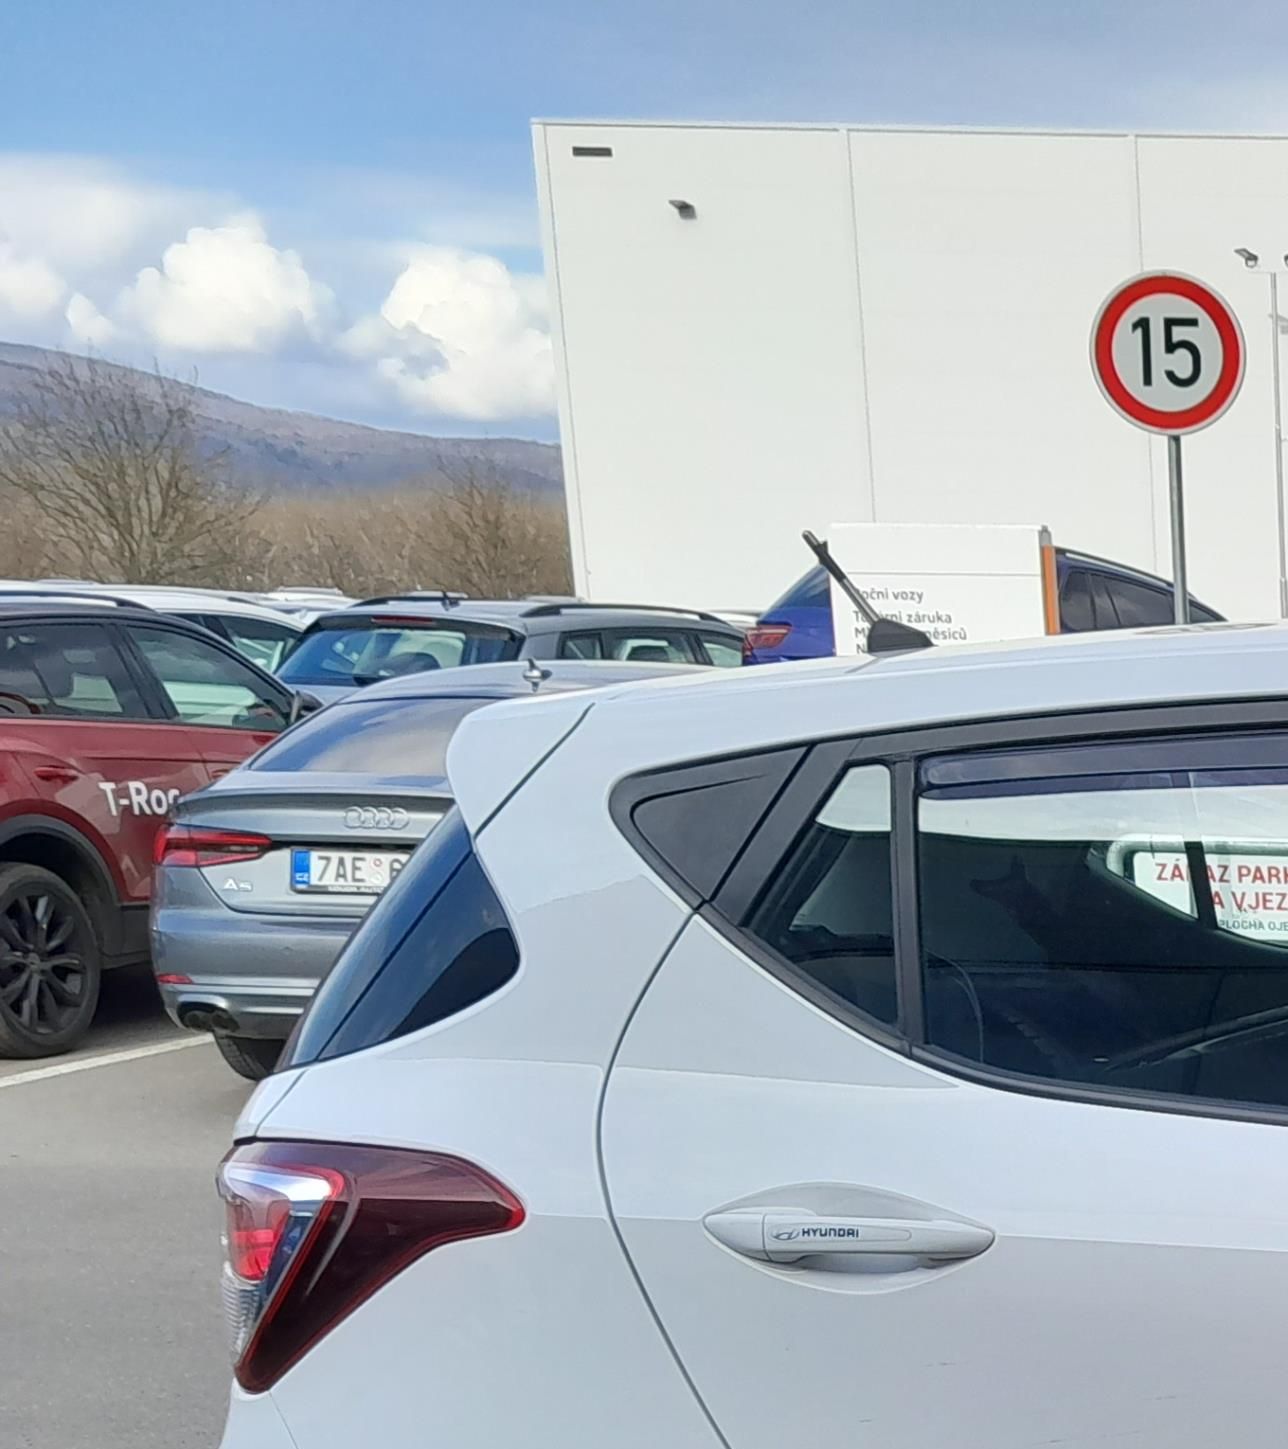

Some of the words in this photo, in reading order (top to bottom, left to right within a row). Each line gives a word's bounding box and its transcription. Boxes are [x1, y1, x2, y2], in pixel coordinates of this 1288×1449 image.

[1132, 316, 1202, 388] 15
[892, 590, 924, 604] vozy
[906, 611, 952, 624] záruka
[317, 855, 367, 883] 7AE
[1155, 857, 1231, 884] ZÁAZ
[801, 1227, 860, 1239] HYUNDAI
